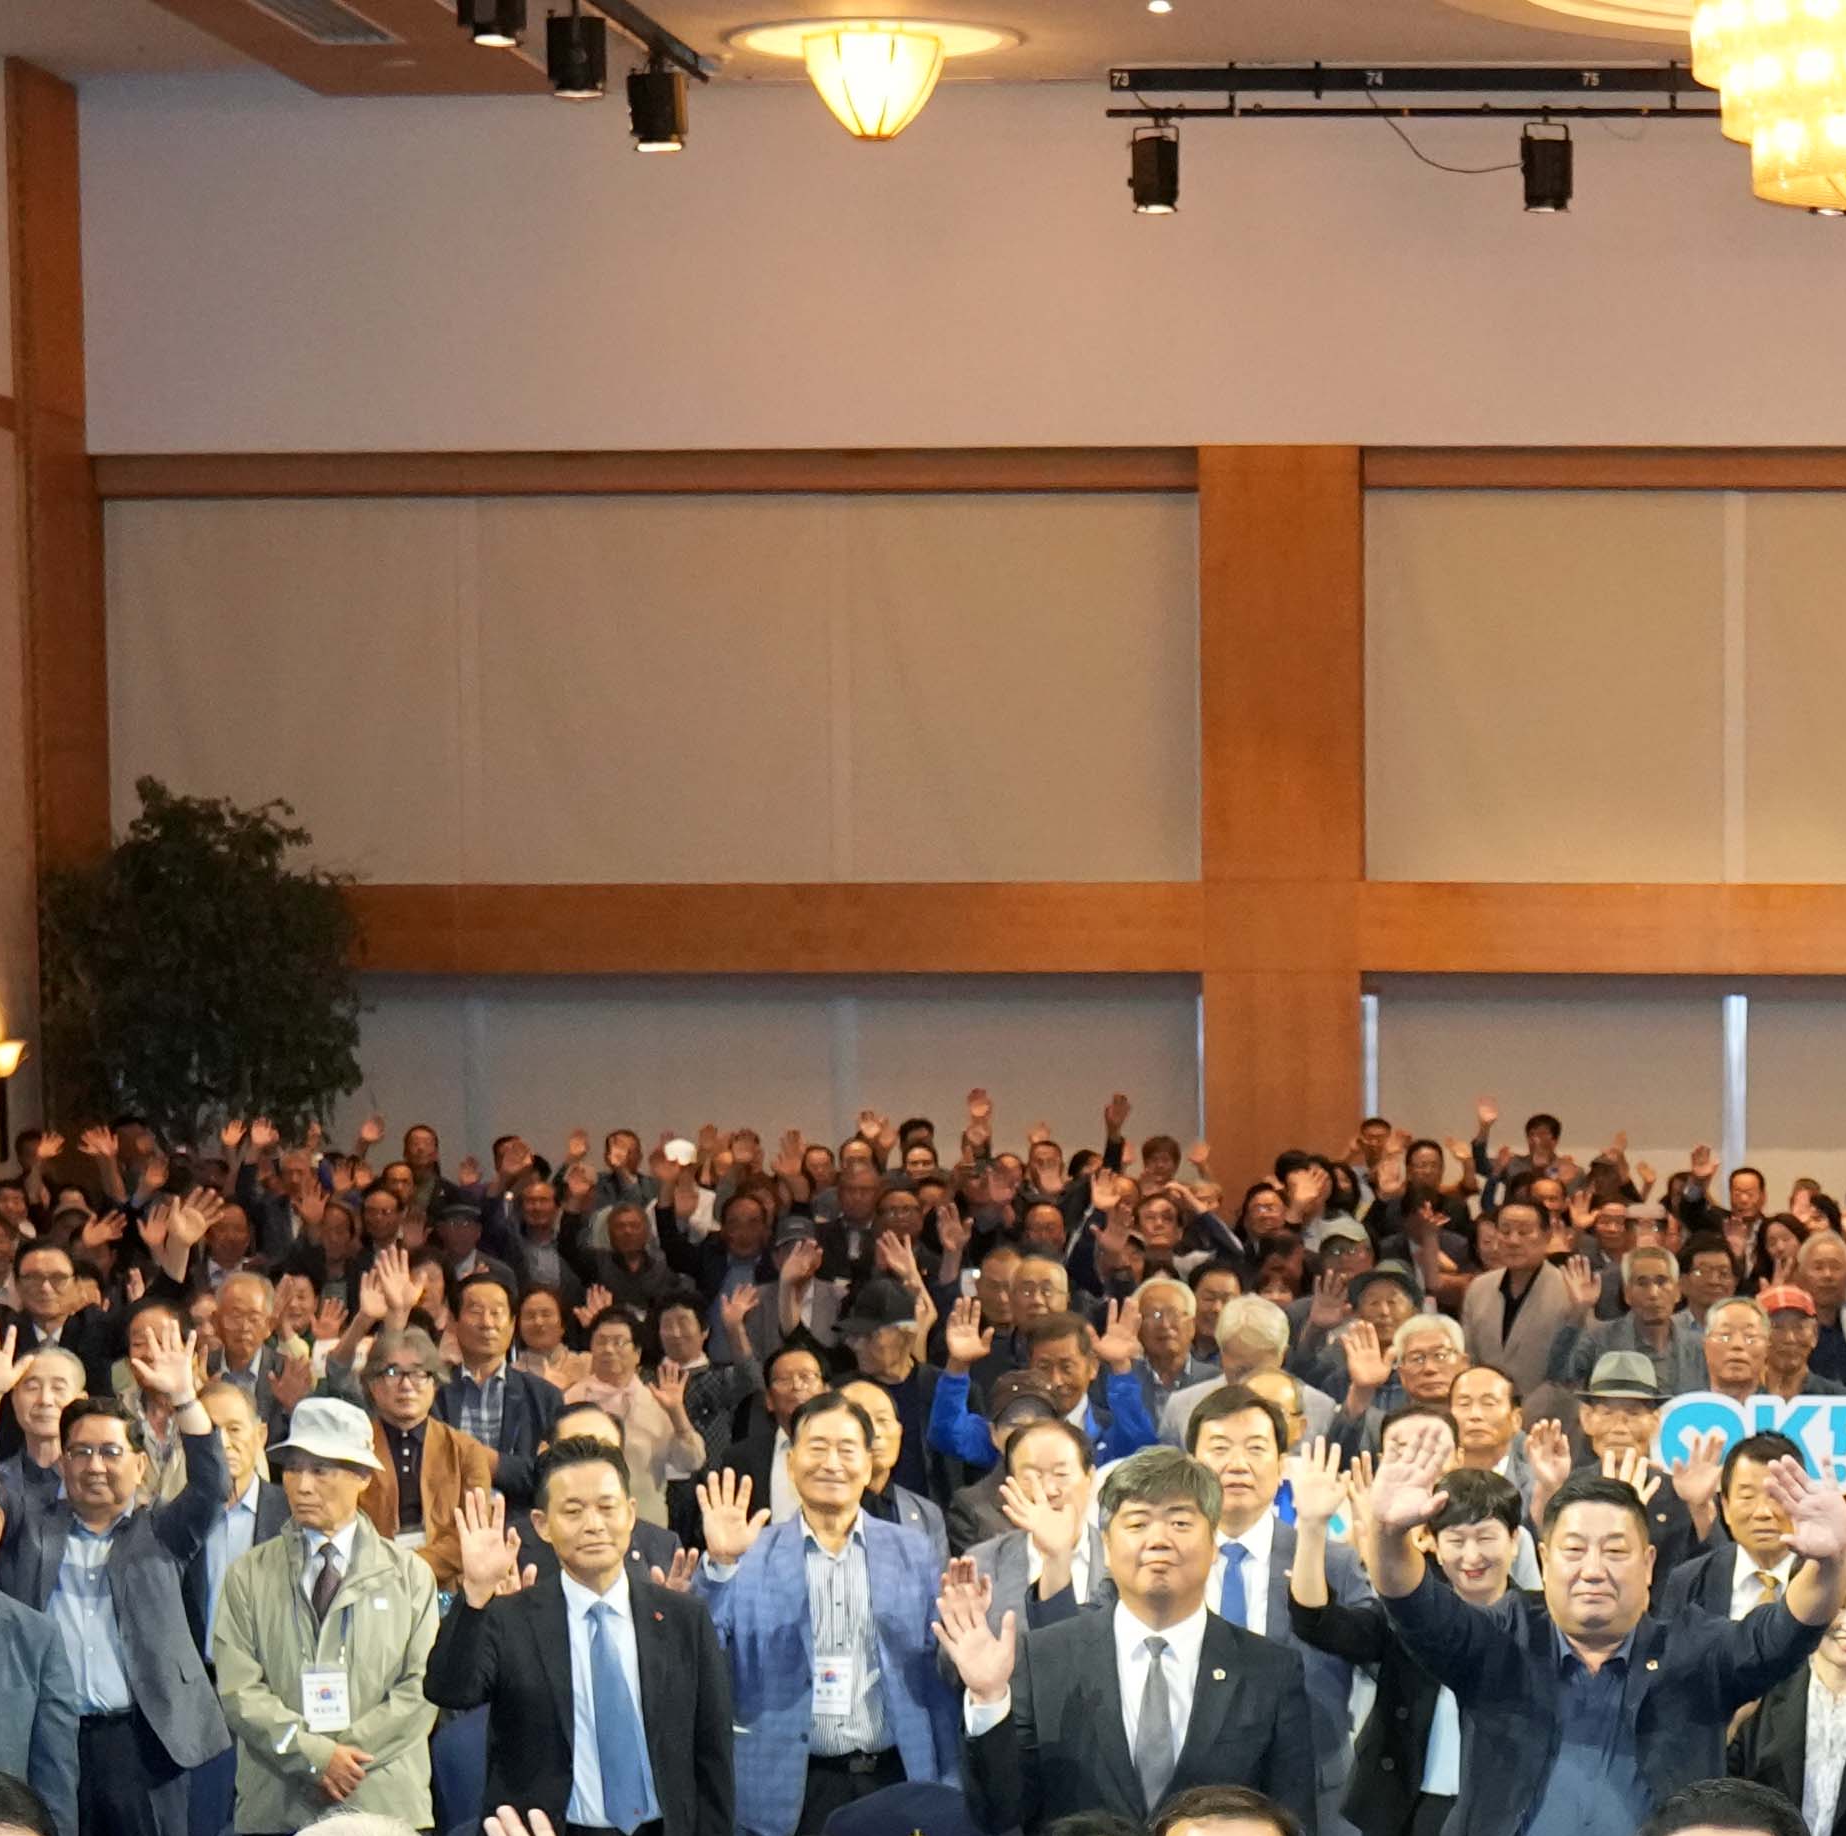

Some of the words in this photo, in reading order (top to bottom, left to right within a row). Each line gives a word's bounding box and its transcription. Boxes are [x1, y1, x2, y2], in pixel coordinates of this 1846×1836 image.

[1112, 72, 1130, 87] 73
[1365, 72, 1384, 87] 74
[1581, 72, 1600, 87] 75
